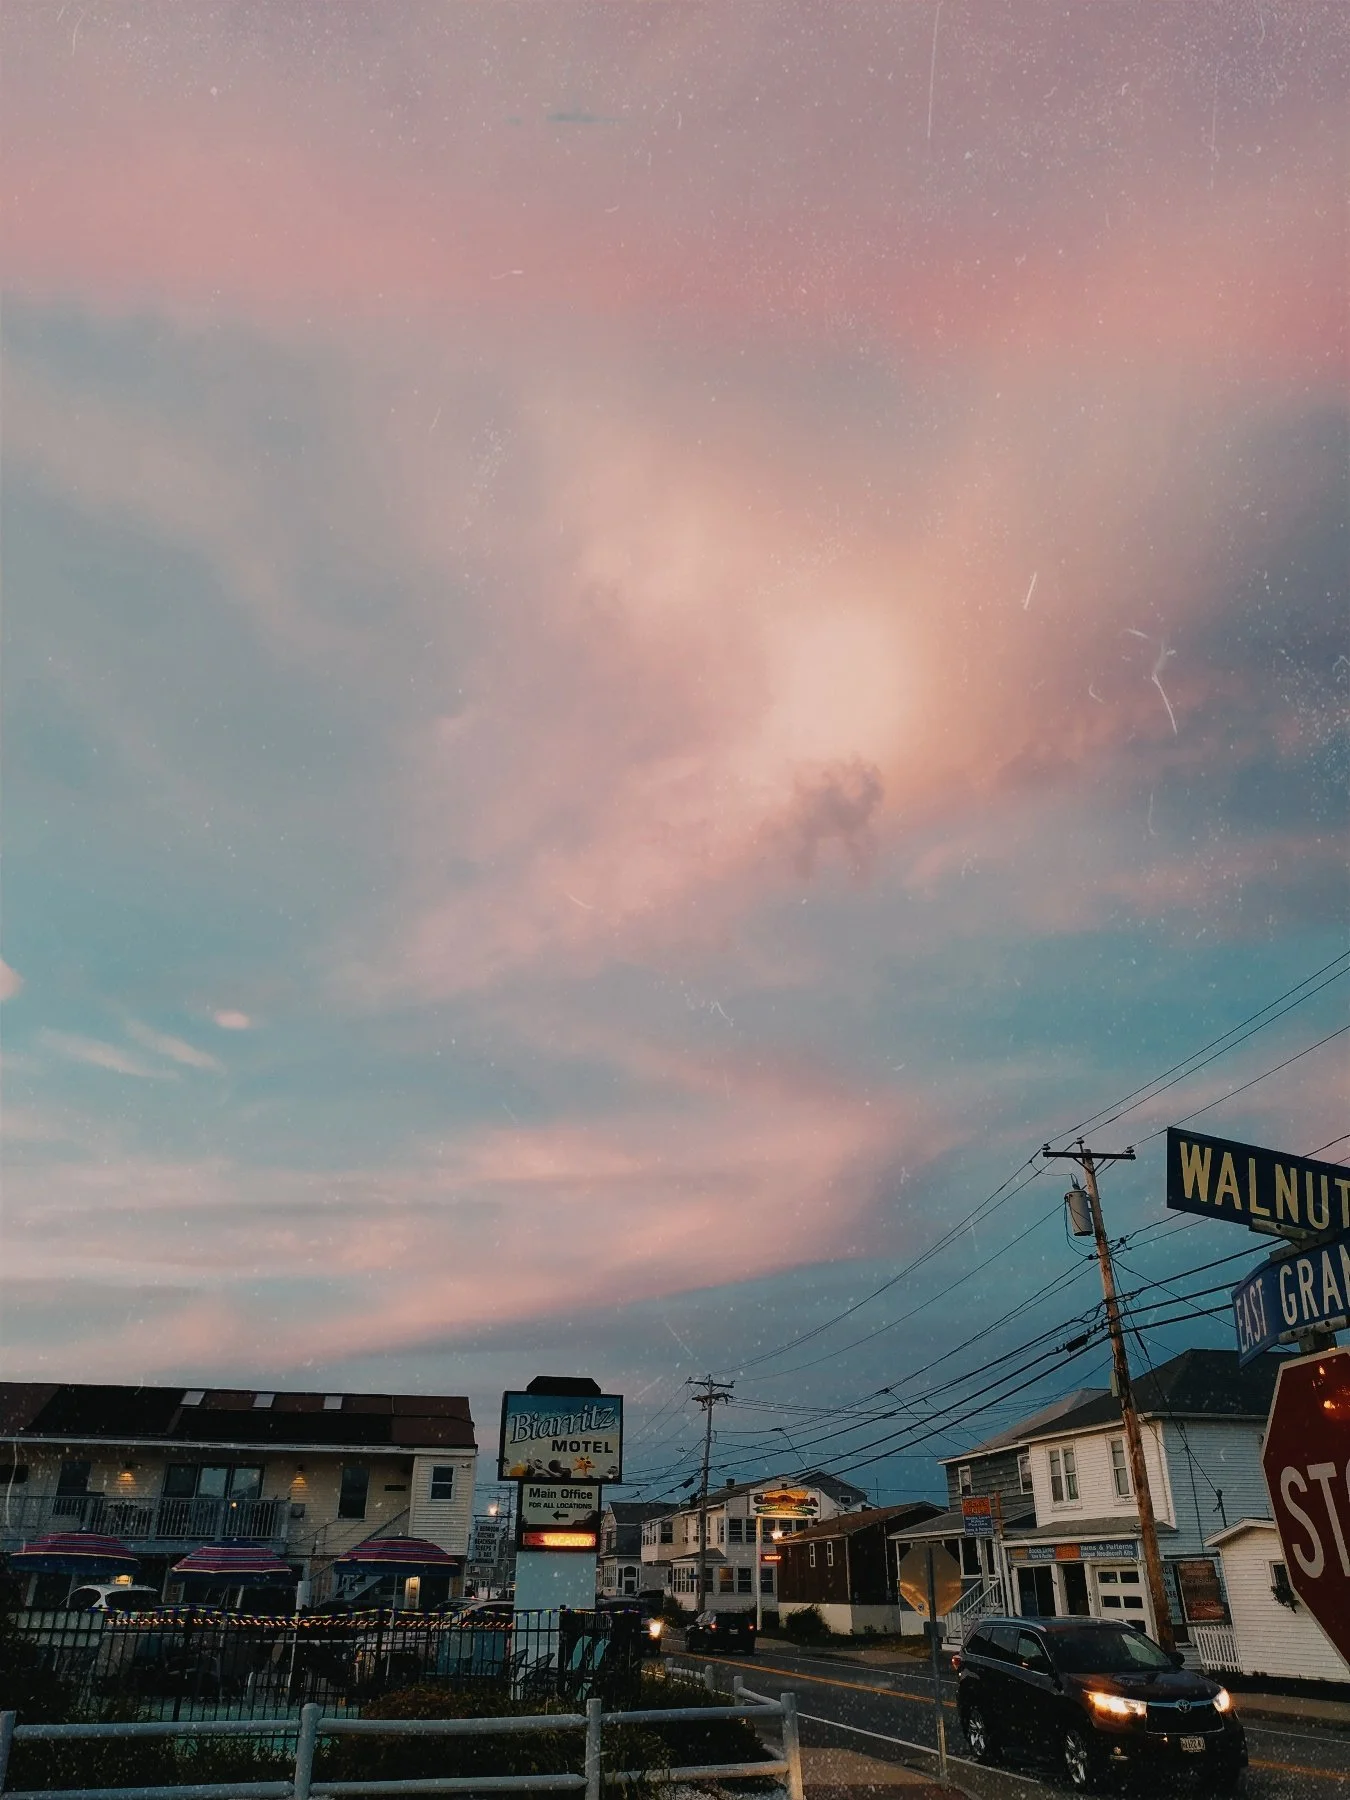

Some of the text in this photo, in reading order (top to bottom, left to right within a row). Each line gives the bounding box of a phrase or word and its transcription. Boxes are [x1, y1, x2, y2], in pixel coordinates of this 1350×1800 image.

[1180, 1141, 1350, 1230] WALNUT
[1236, 1278, 1267, 1354] EAST
[509, 1404, 616, 1444] Biarritz
[551, 1440, 613, 1453] MOTEL
[529, 1488, 592, 1499] Main Office
[1280, 1458, 1350, 1578] ST
[543, 1535, 592, 1546] VACANCY
[1106, 1542, 1133, 1550] Patterns
